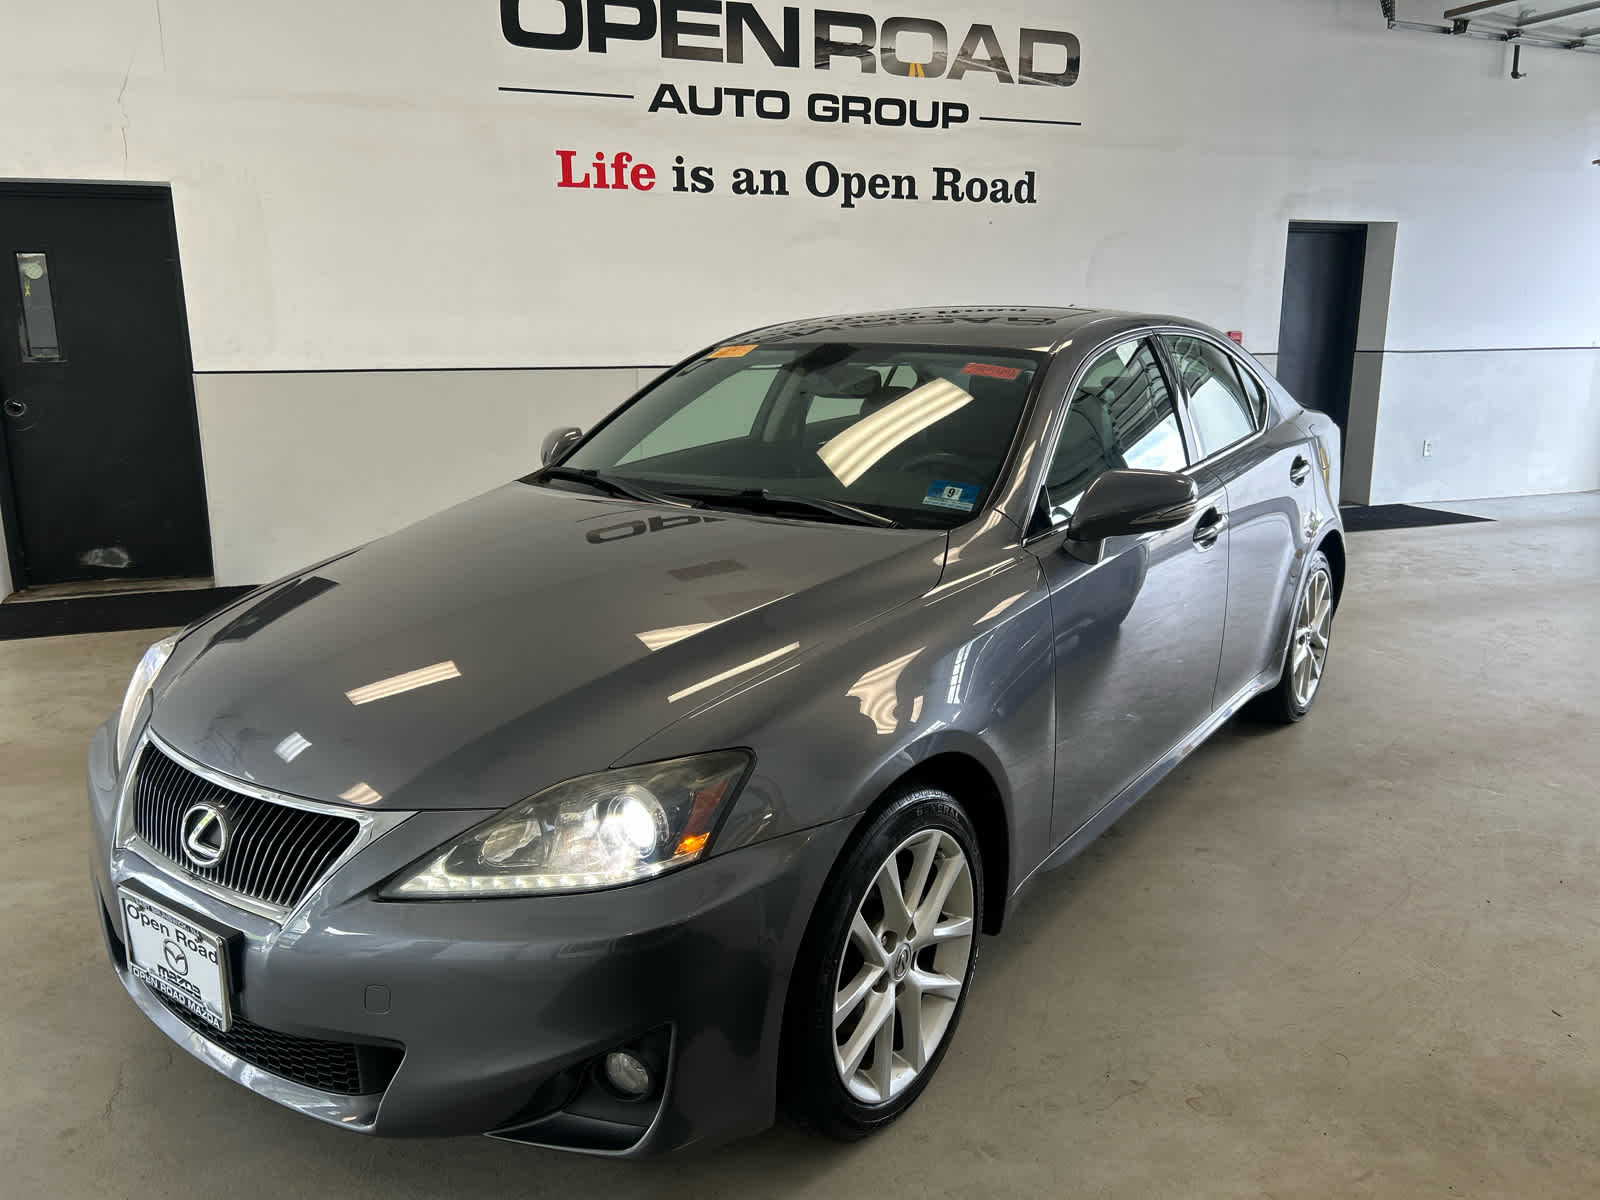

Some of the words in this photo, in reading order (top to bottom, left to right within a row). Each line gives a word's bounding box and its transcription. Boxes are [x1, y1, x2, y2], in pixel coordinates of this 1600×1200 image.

[499, 0, 800, 68] OPEN
[814, 8, 1081, 87] ROAD
[648, 83, 790, 120] AUTO
[807, 93, 969, 129] GROUP
[556, 150, 656, 192] Life
[672, 155, 714, 194] is
[731, 166, 789, 196] an
[805, 161, 919, 208] Open
[932, 167, 1036, 204] Road
[126, 903, 170, 937] Open
[176, 930, 218, 965] Road
[132, 967, 159, 988] OPEN
[160, 983, 186, 1005] ROAD
[187, 1001, 221, 1029] MAZDA
